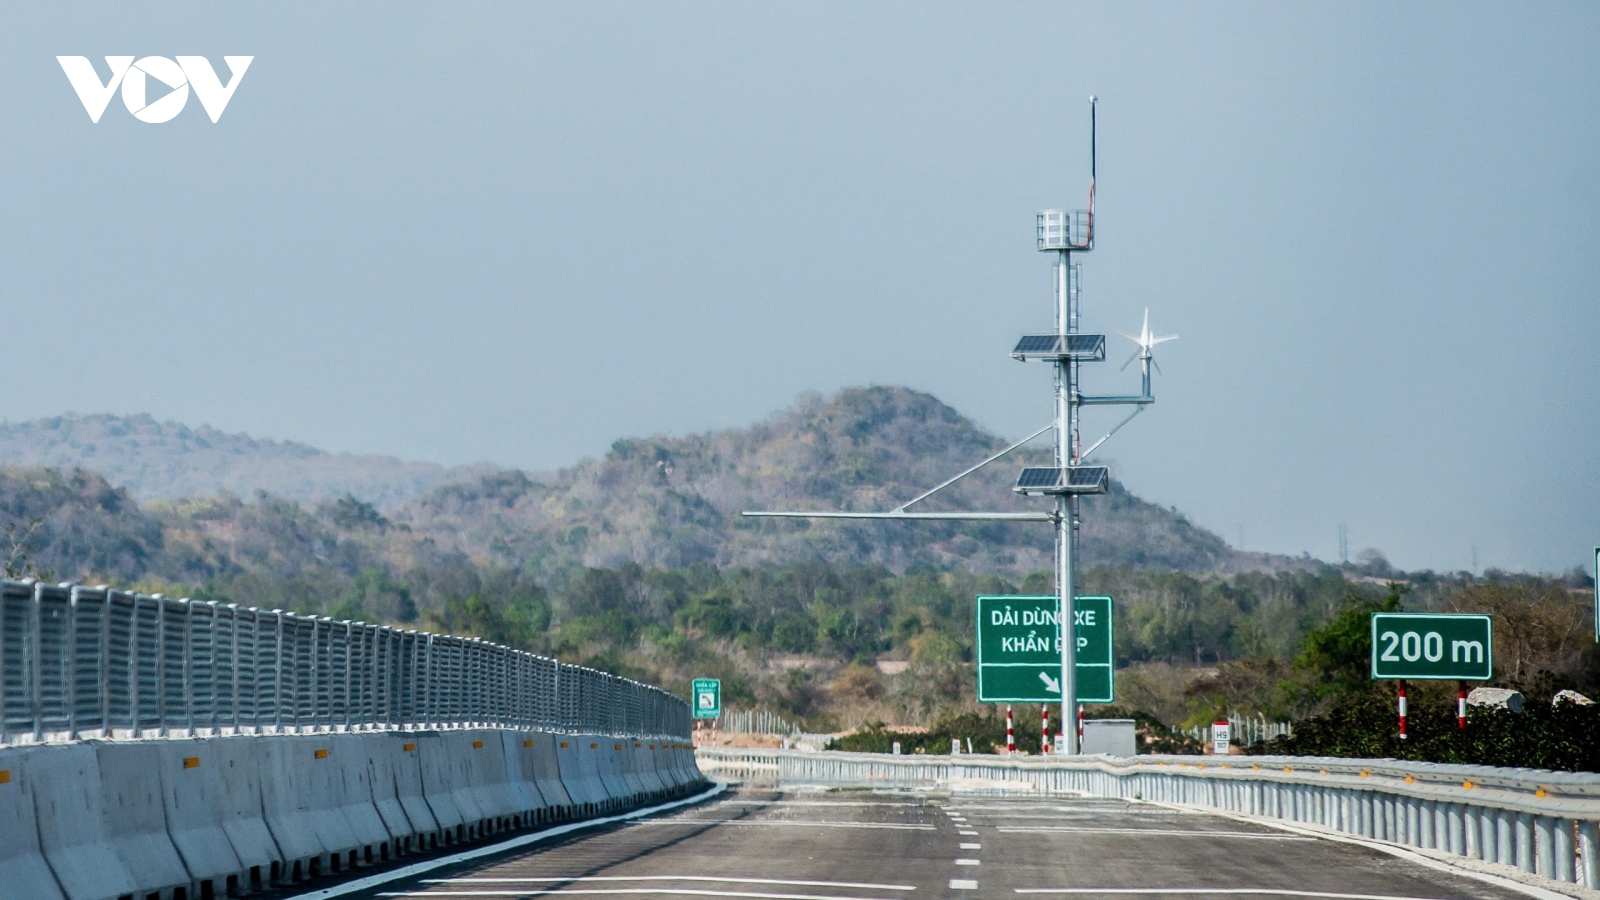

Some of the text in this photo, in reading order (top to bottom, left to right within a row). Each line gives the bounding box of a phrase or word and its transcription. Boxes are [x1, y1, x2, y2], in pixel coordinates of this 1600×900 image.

[991, 604, 1019, 627] DẢI
[1073, 609, 1097, 627] XE
[1001, 629, 1089, 653] KHẨN CP
[1380, 631, 1484, 663] 200 m
[1216, 730, 1228, 740] H9
